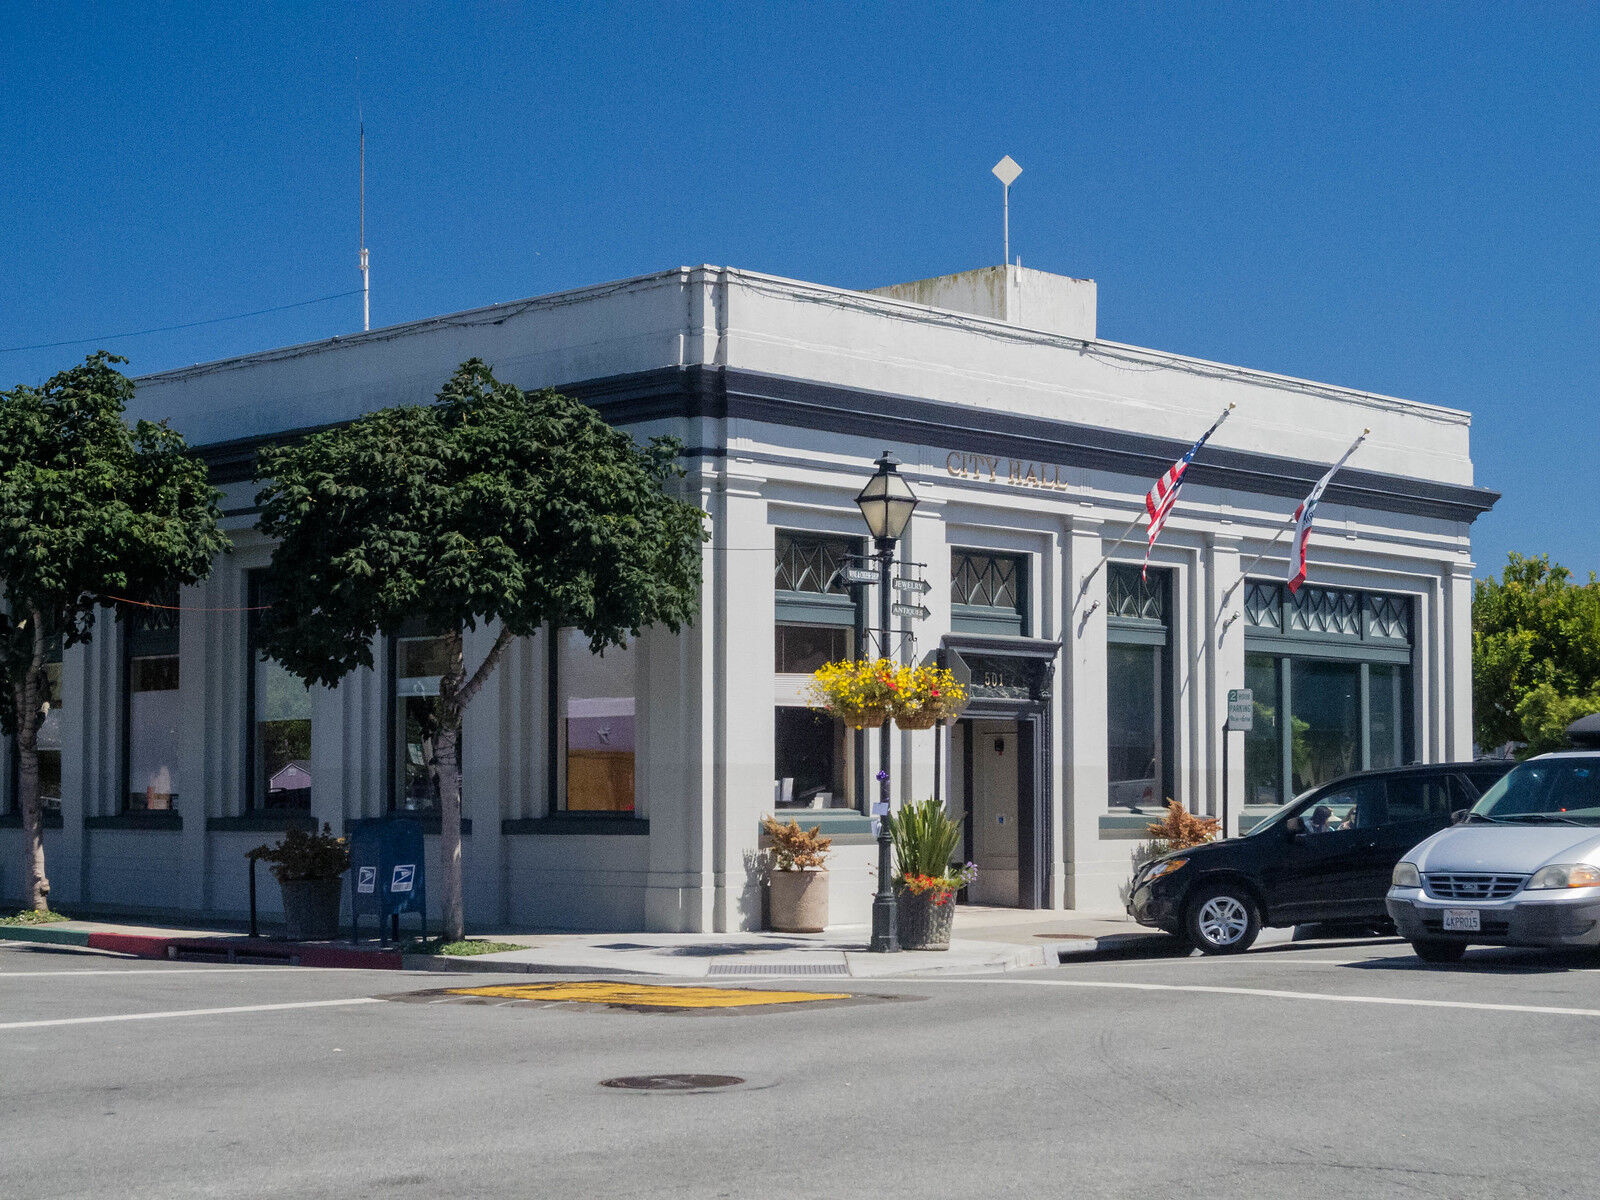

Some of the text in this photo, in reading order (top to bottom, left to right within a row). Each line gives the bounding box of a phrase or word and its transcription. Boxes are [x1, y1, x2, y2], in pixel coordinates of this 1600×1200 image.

[946, 451, 1068, 491] CITY HALL
[894, 579, 923, 590] JEWELRY
[893, 606, 924, 616] ANTIQUES
[984, 672, 1003, 687] 501
[1230, 691, 1237, 701] 2
[1229, 705, 1251, 713] PARKING
